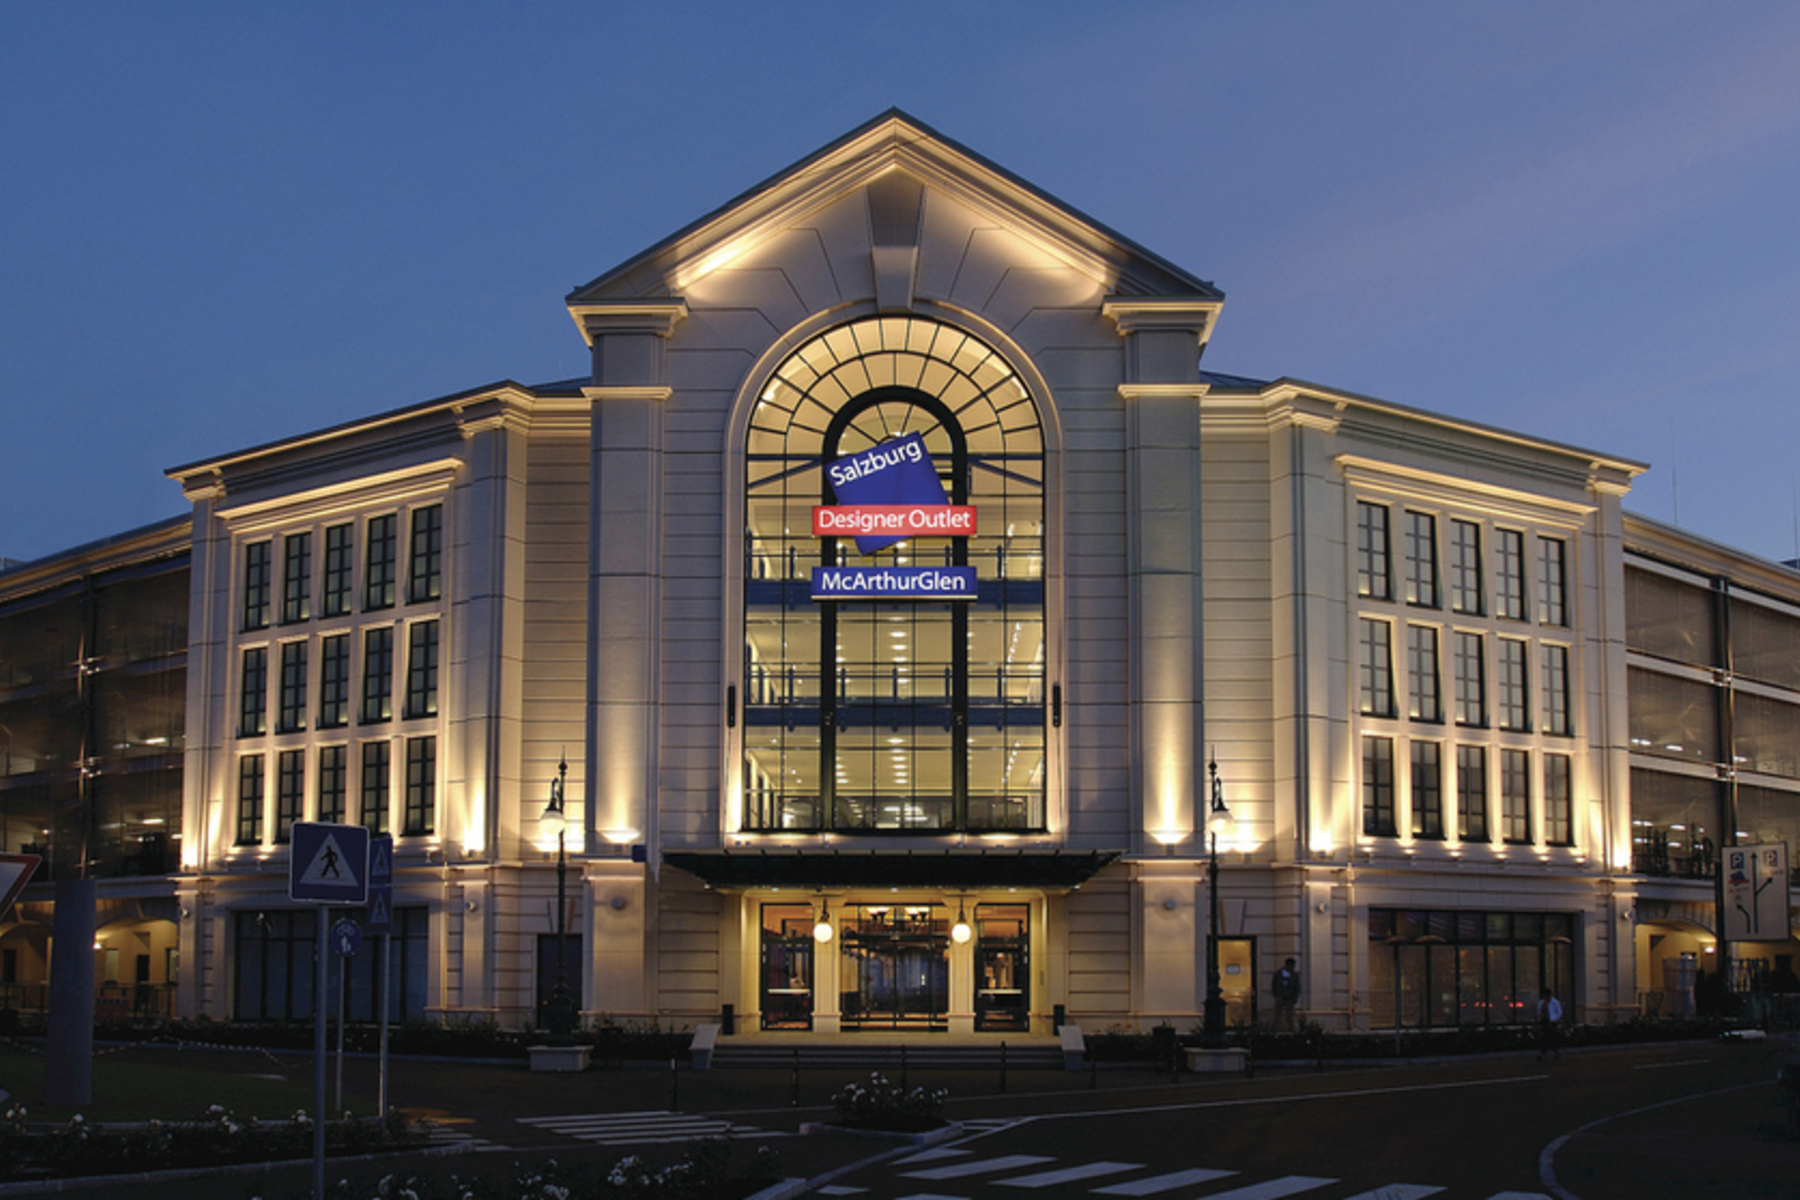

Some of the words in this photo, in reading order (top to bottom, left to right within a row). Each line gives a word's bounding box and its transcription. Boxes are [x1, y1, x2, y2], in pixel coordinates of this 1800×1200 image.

[829, 440, 922, 486] Salzburg
[819, 509, 906, 532] Designer
[908, 509, 971, 528] Outlet
[821, 571, 966, 590] McArthurGlen
